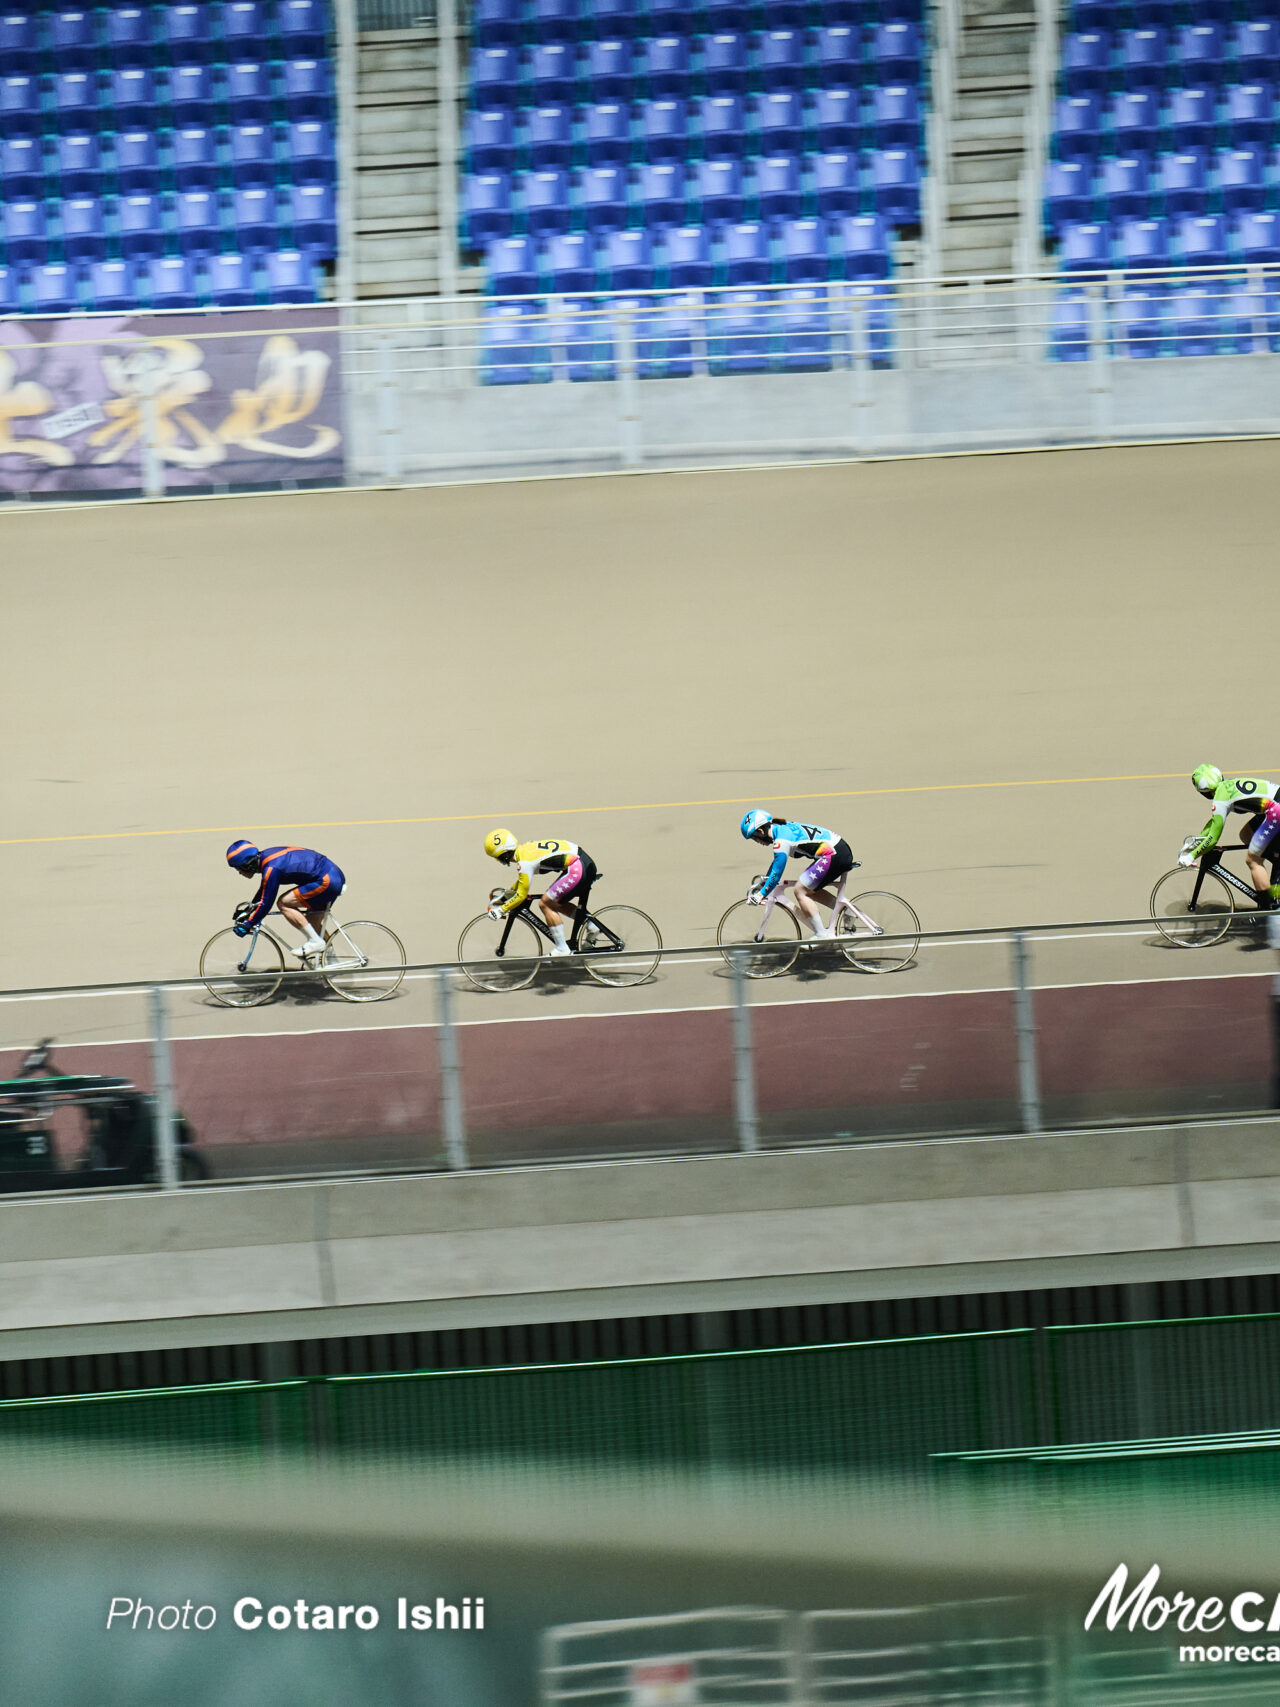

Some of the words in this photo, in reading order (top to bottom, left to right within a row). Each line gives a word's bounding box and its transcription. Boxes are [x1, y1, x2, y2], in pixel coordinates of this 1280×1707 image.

[1235, 780, 1258, 795] 6
[744, 815, 752, 825] 4
[493, 834, 502, 846] 5
[801, 825, 822, 841] 4
[537, 841, 560, 853] 5
[1211, 864, 1258, 898] BRIDGESTONE
[521, 908, 554, 938] BRIDGESTO
